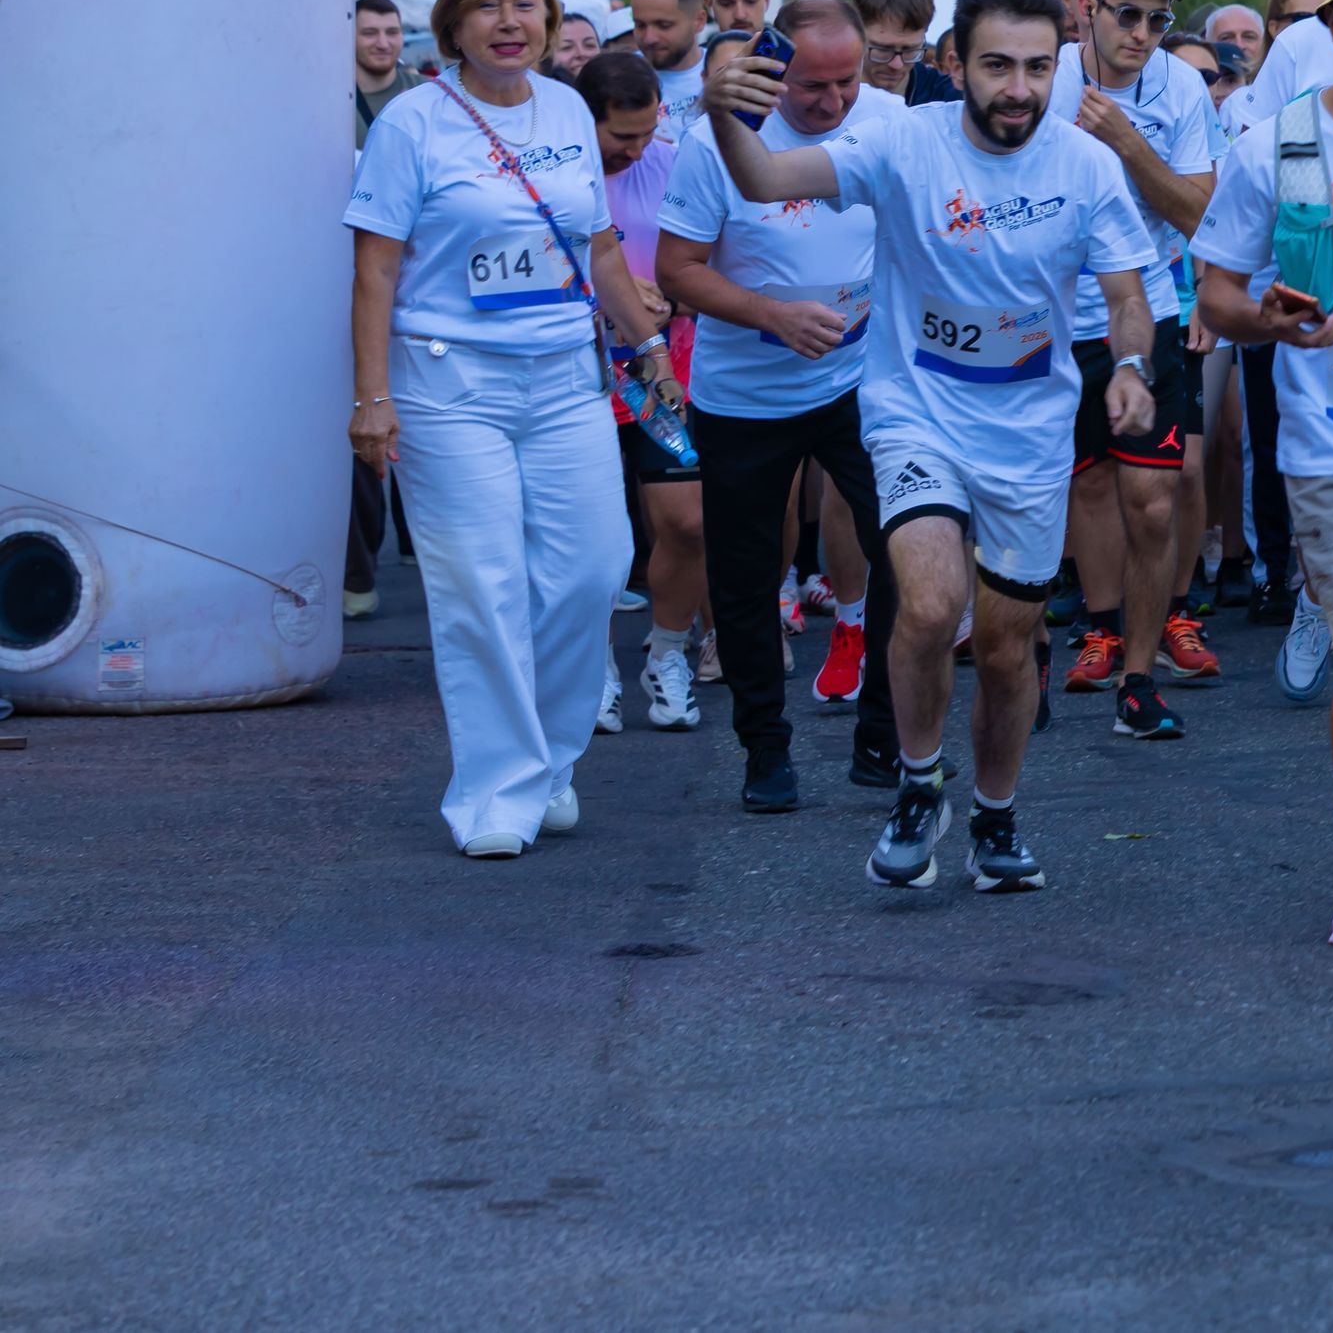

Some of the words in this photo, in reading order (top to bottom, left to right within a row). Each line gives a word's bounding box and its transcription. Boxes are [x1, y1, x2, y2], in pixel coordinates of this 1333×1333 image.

[983, 198, 1021, 220] AGBU
[985, 207, 1029, 230] Global
[1032, 200, 1060, 217] Run
[471, 248, 534, 283] 614
[922, 311, 982, 353] 592
